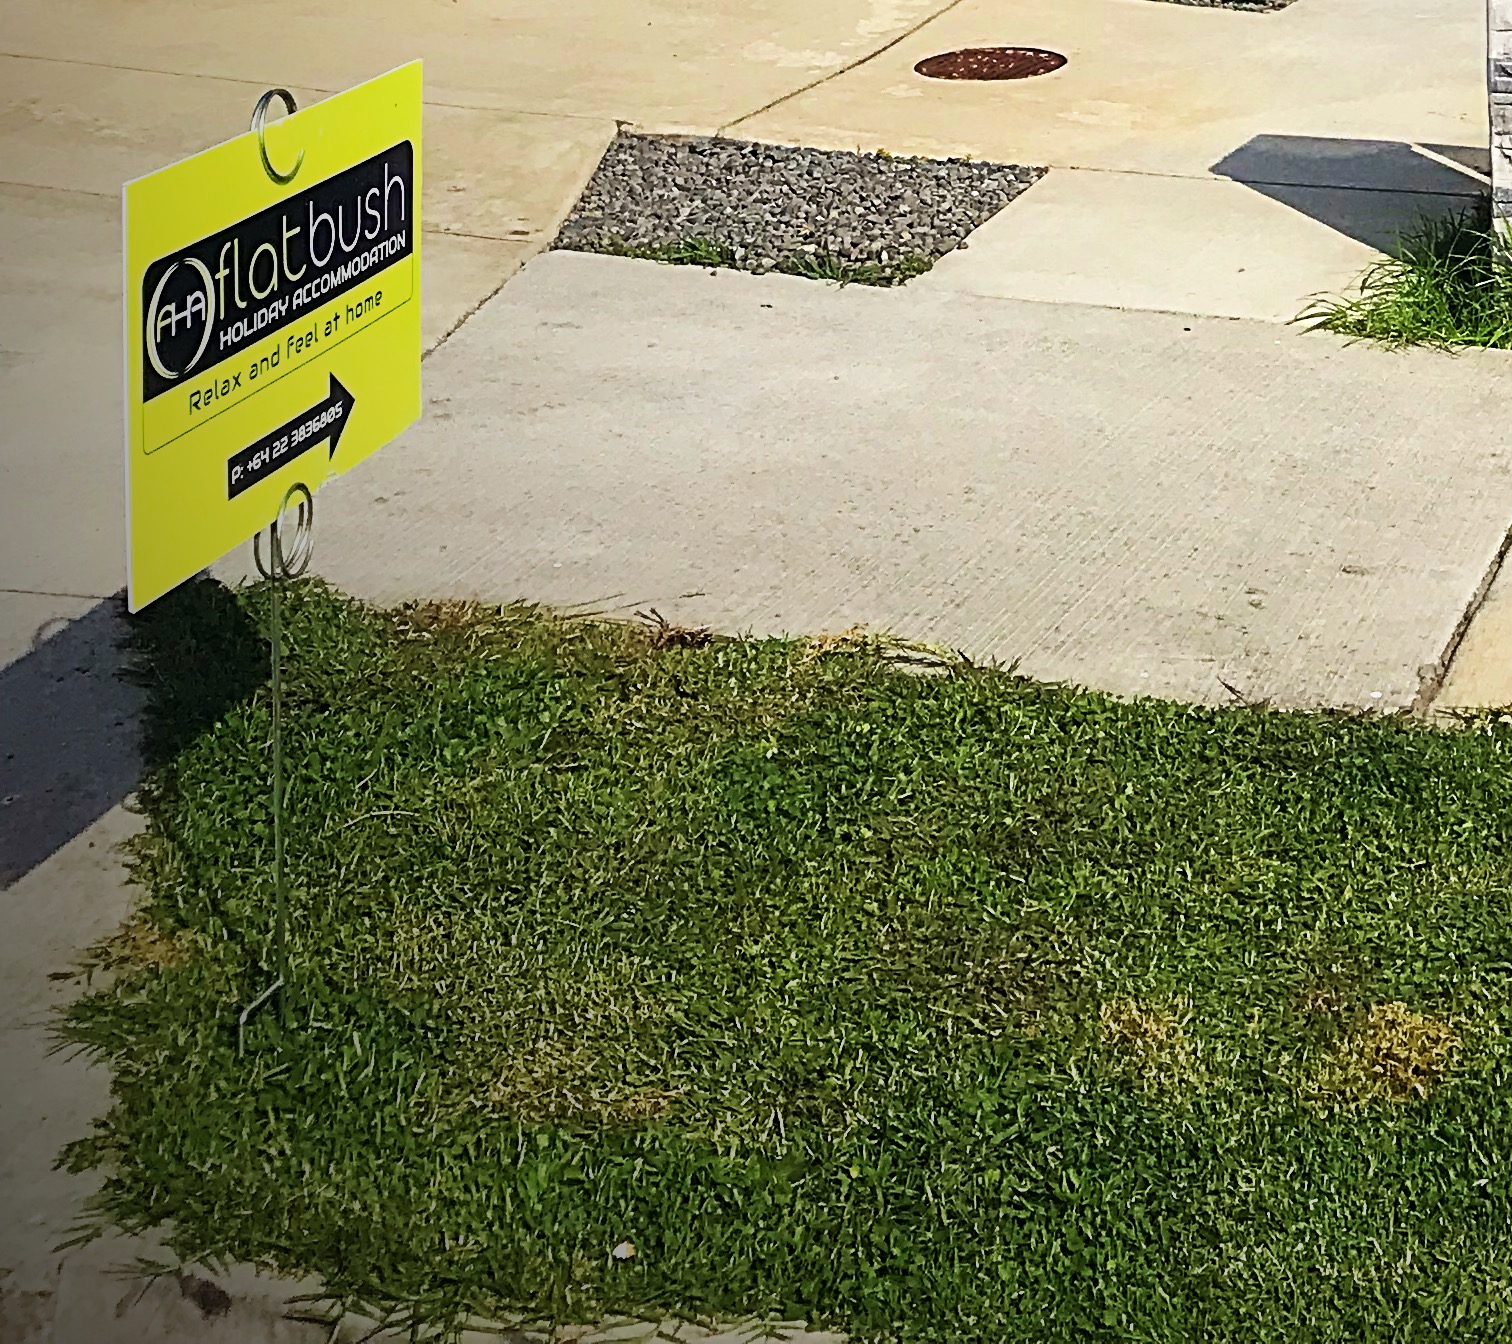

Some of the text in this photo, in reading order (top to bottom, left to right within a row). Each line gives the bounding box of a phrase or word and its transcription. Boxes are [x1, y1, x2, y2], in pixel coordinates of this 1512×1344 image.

[214, 162, 405, 321] flatbush
[219, 229, 407, 351] HOLIDAY ACCOMMODATION
[188, 290, 383, 416] Relax and Feel at home
[231, 399, 343, 485] P: +64 22 3836805
